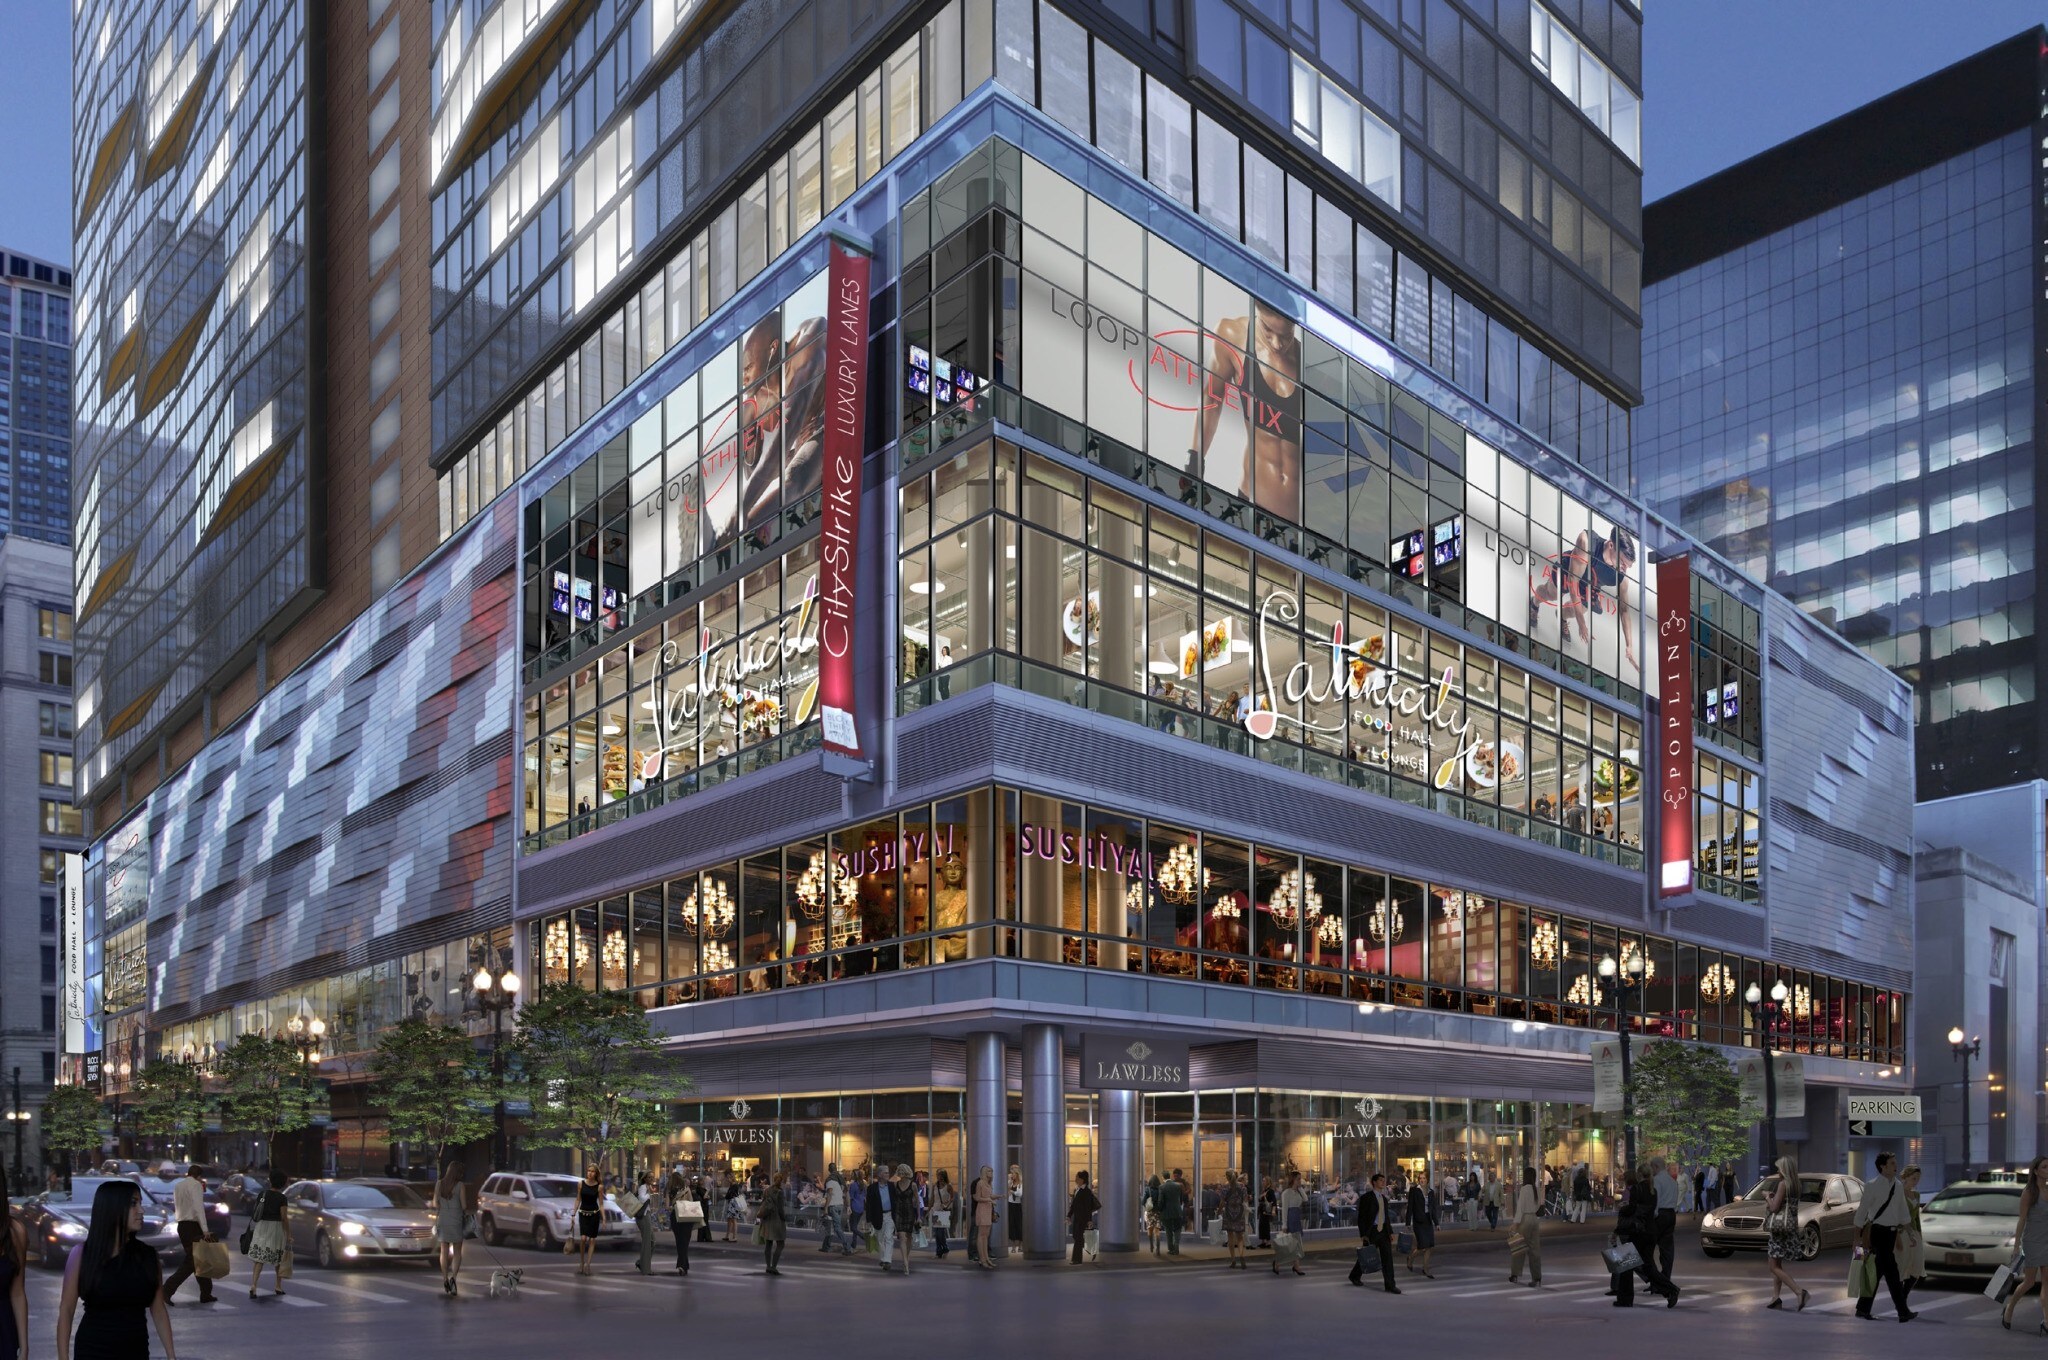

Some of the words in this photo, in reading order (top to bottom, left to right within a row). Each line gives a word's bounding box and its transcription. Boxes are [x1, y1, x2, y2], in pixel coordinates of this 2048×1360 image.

[840, 277, 860, 346] LANES
[1051, 287, 1140, 351] LOOP
[837, 349, 857, 436] LUXURY
[1150, 345, 1283, 435] ATHLETIX
[646, 473, 692, 518] LOOP
[823, 456, 854, 658] CityStrike
[718, 690, 752, 712] FOOD
[759, 671, 797, 693] HALL
[1245, 591, 1484, 790] Latinicity
[1667, 644, 1681, 779] POPLIN
[1354, 710, 1393, 732] FOOD
[1400, 725, 1436, 747] HALL
[1371, 746, 1424, 773] LOUNGE
[1098, 1062, 1181, 1083] LAWLESS
[1332, 1123, 1412, 1138] LAWLESS
[1850, 1101, 1916, 1115] PARKING
[703, 1128, 774, 1143] LAWLESS
